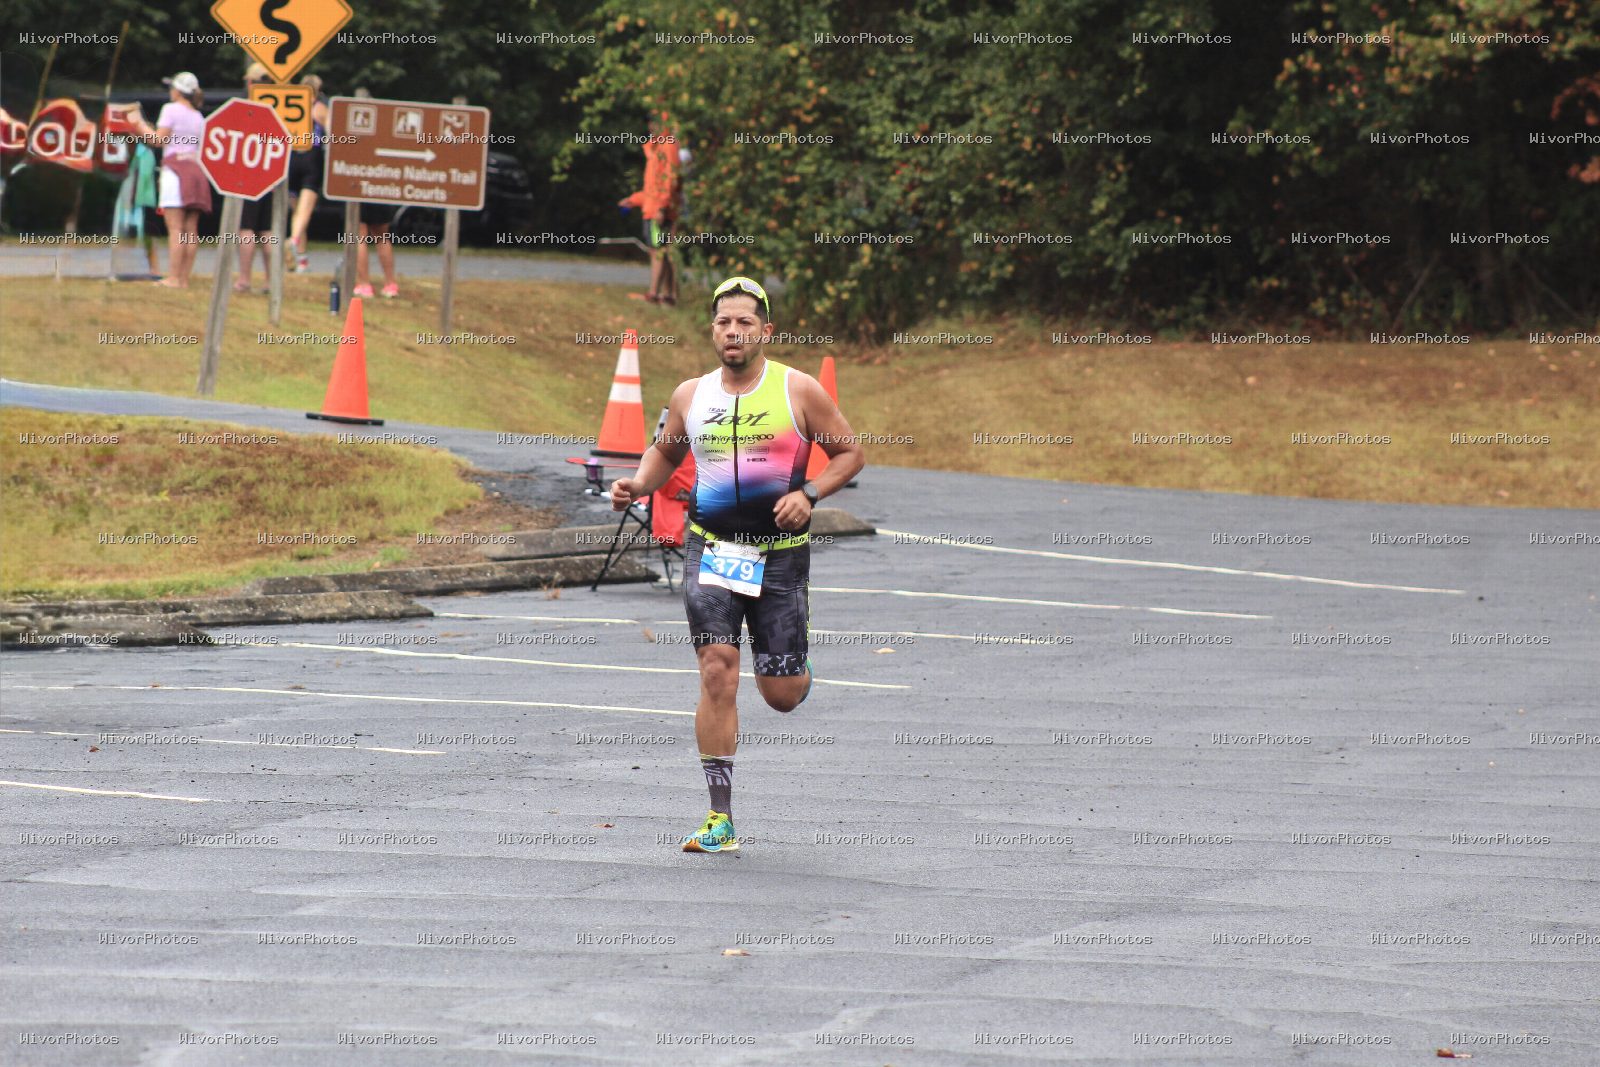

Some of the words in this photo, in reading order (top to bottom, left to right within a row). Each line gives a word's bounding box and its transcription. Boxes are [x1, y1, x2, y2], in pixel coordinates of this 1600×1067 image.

[205, 126, 285, 171] STOP
[333, 160, 401, 180] Muscadine
[403, 165, 447, 183] Nature
[449, 168, 477, 185] Trail
[360, 181, 401, 198] Tennis
[403, 184, 447, 201] Courts
[711, 556, 754, 581] 379
